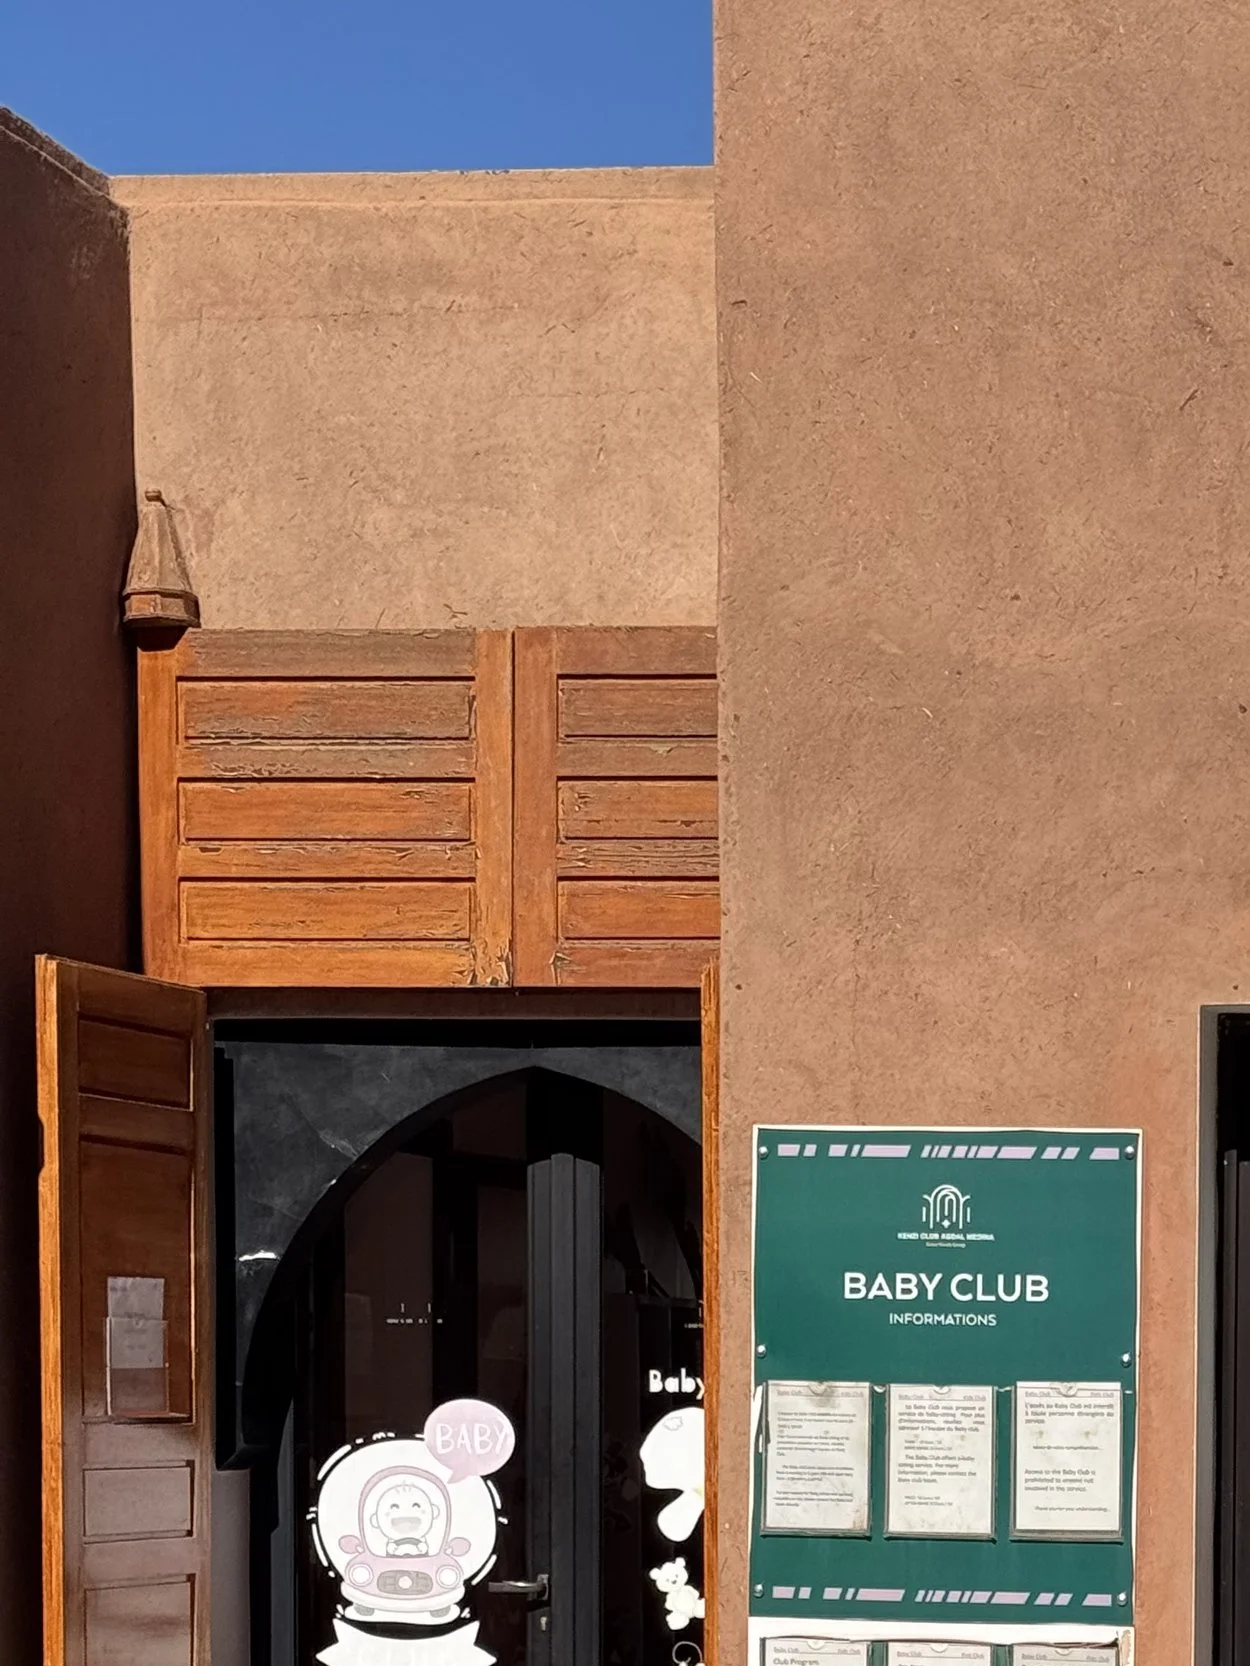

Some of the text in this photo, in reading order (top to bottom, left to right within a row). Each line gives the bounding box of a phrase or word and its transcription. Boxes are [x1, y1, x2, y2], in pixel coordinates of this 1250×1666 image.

[844, 1271, 1049, 1302] BABY CLUB
[889, 1312, 997, 1326] INFORMATIONS
[436, 1421, 507, 1455] BABY
